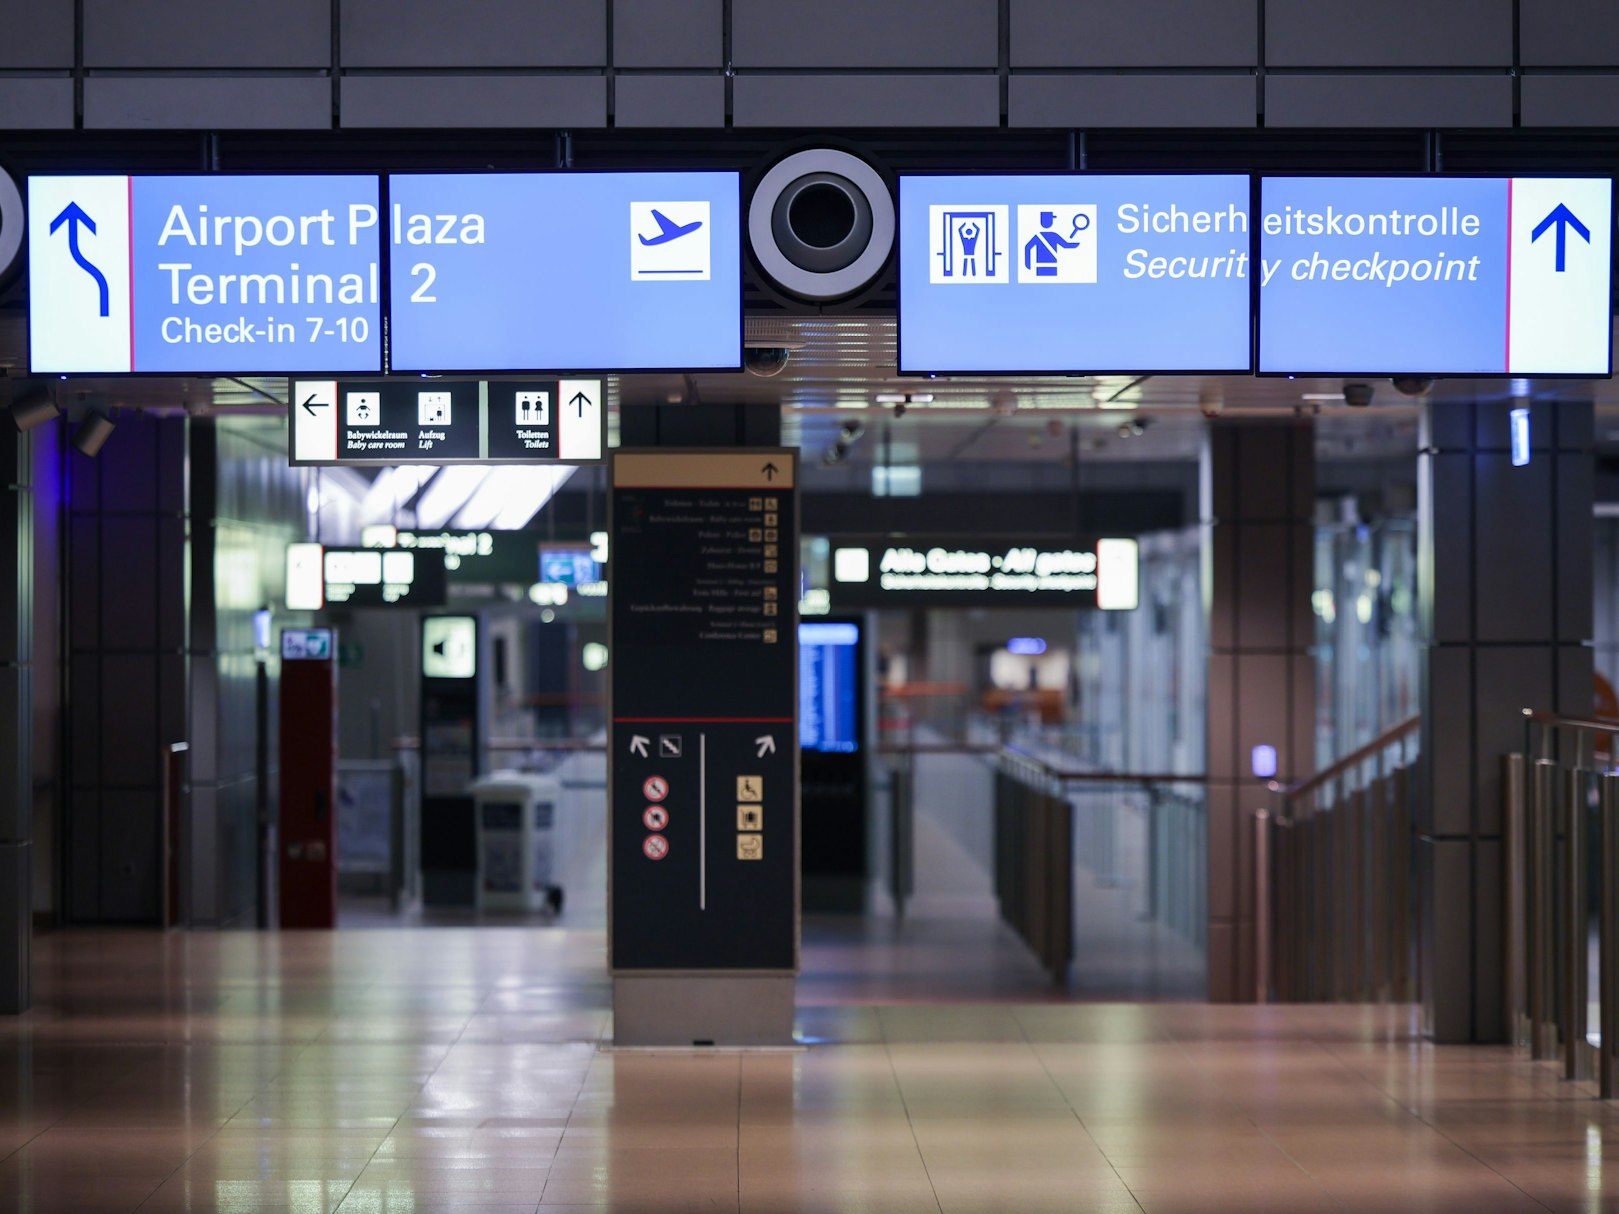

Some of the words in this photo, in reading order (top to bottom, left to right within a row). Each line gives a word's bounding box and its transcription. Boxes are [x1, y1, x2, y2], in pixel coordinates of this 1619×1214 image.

[1117, 203, 1480, 236] Sicherheitskontrolle
[158, 204, 335, 255] Airport
[349, 203, 485, 245] Plaza
[1123, 248, 1281, 286] Security
[1291, 251, 1481, 287] checkpoint
[158, 263, 378, 304] Terminal
[410, 262, 437, 303] 2
[161, 316, 295, 343] Check-in
[306, 317, 369, 343] 7-10
[347, 430, 408, 441] Babywickelraum
[418, 430, 446, 441] Aufzug
[516, 430, 549, 439] Toiletten
[347, 440, 367, 450] Baby
[418, 440, 434, 450] Lift
[524, 439, 549, 449] Toilets
